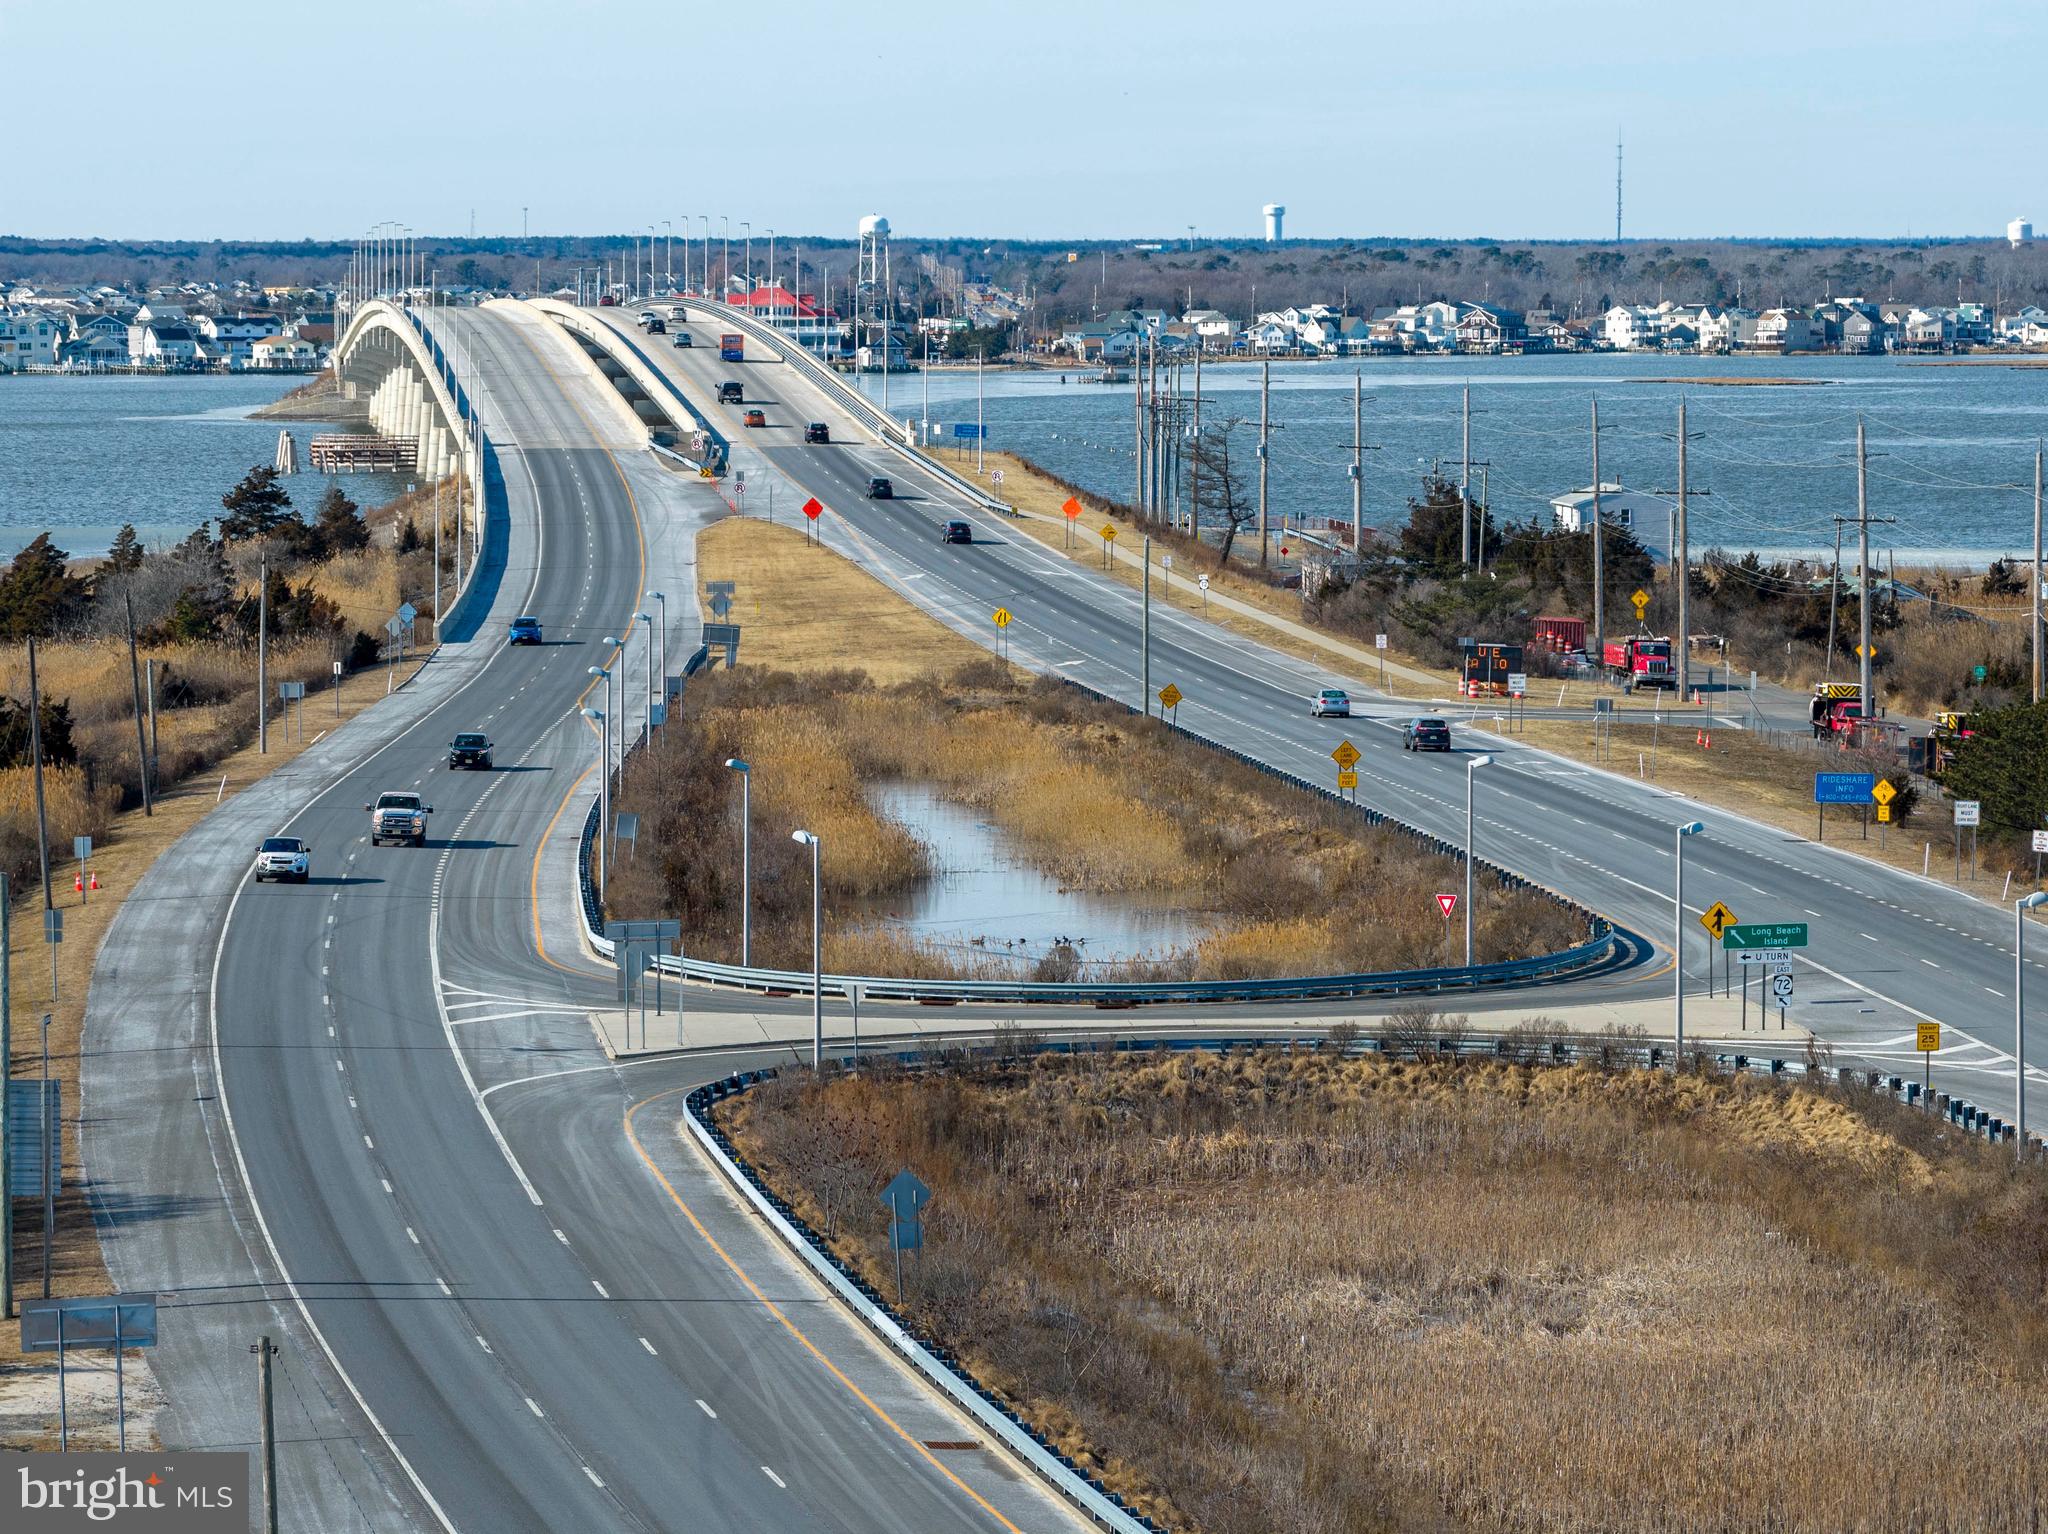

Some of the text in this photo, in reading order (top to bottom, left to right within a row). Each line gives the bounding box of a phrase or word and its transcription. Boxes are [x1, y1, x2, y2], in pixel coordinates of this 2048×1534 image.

[1822, 775, 1868, 784] RIDESHARE
[1835, 785, 1854, 793] INFO
[1751, 926, 1801, 937] Long Beach
[1764, 937, 1788, 945] Island
[1755, 952, 1789, 961] U TURN
[1776, 979, 1790, 990] 72
[1922, 1034, 1936, 1043] 25
